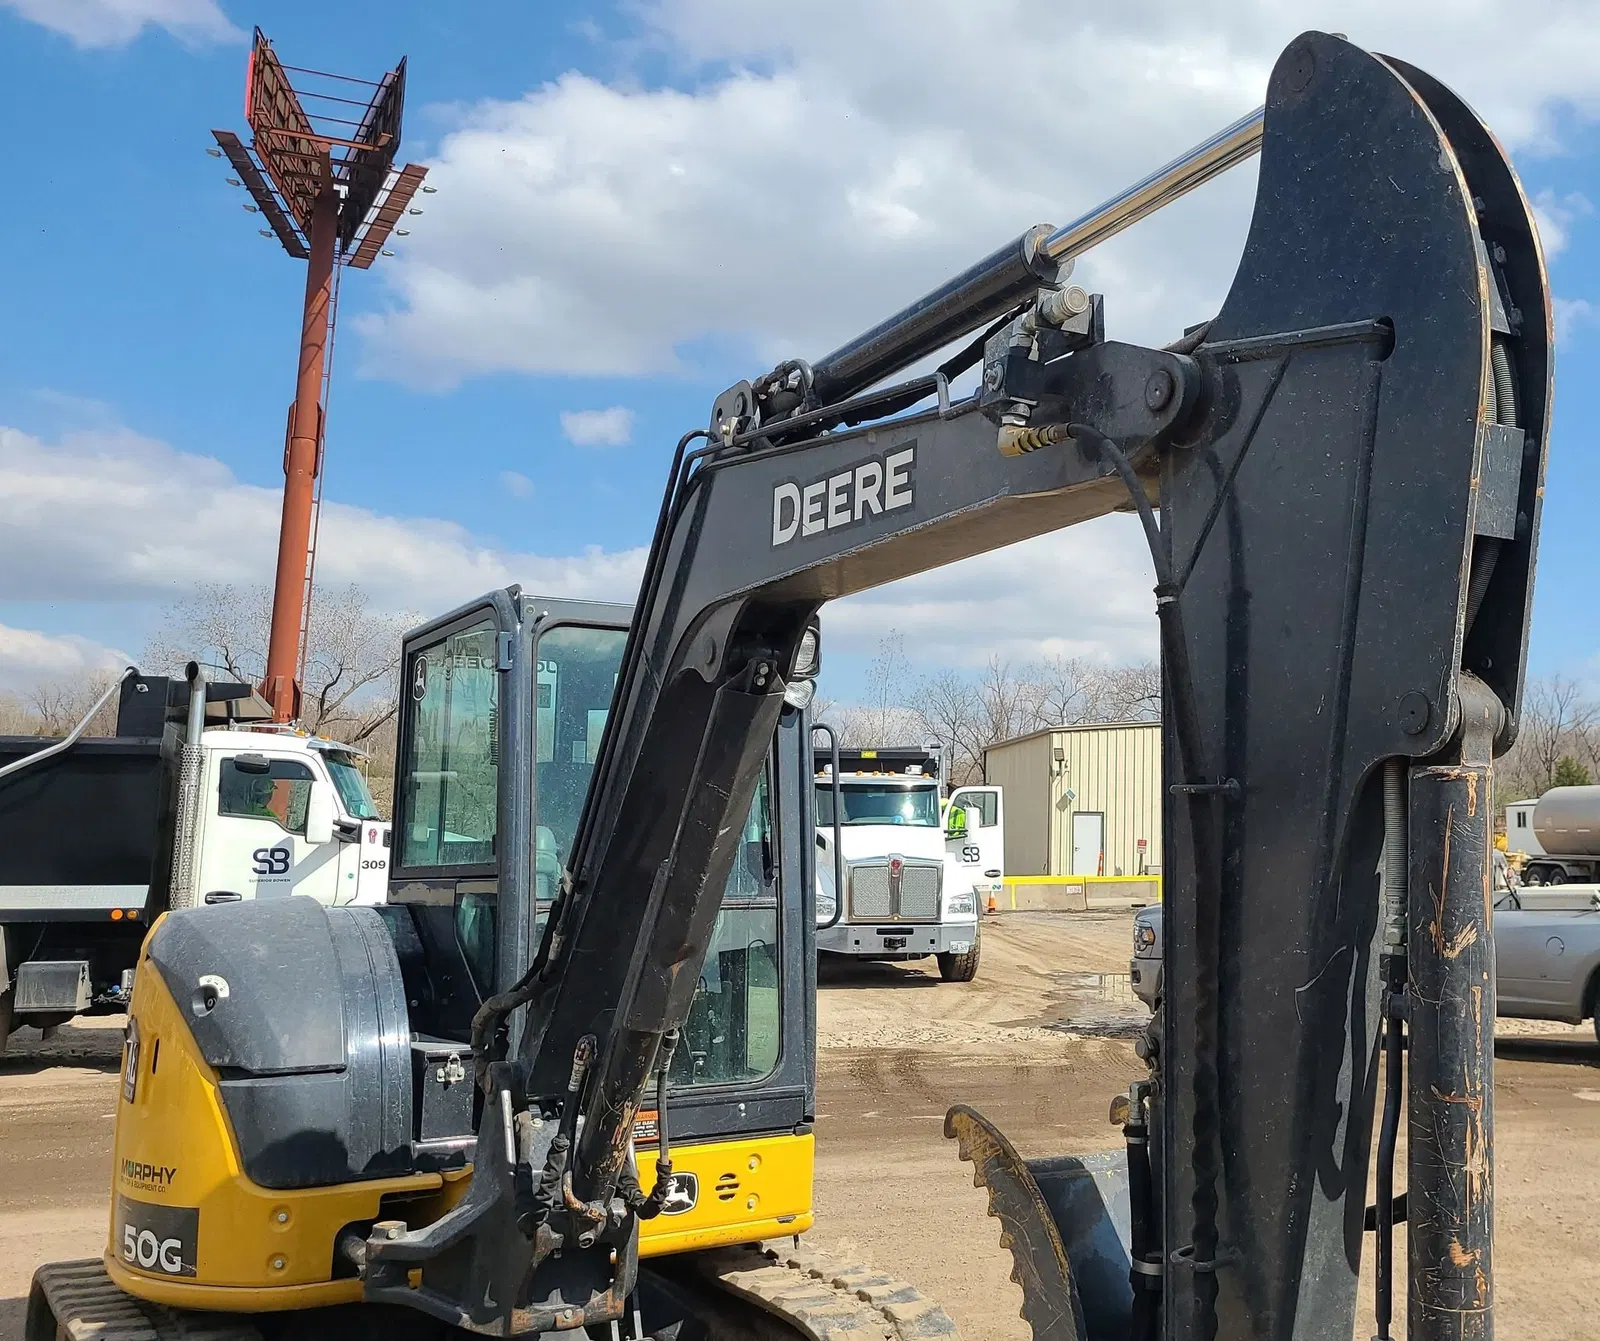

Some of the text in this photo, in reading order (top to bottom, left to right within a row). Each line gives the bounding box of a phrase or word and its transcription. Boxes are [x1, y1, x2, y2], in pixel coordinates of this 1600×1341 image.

[773, 448, 914, 546] DEERE
[252, 847, 291, 875] SB
[361, 860, 386, 870] 309
[962, 846, 981, 863] SB
[121, 1158, 177, 1185] MURPHY
[134, 1180, 157, 1192] EQUIPMENT
[124, 1223, 182, 1273] 50G
